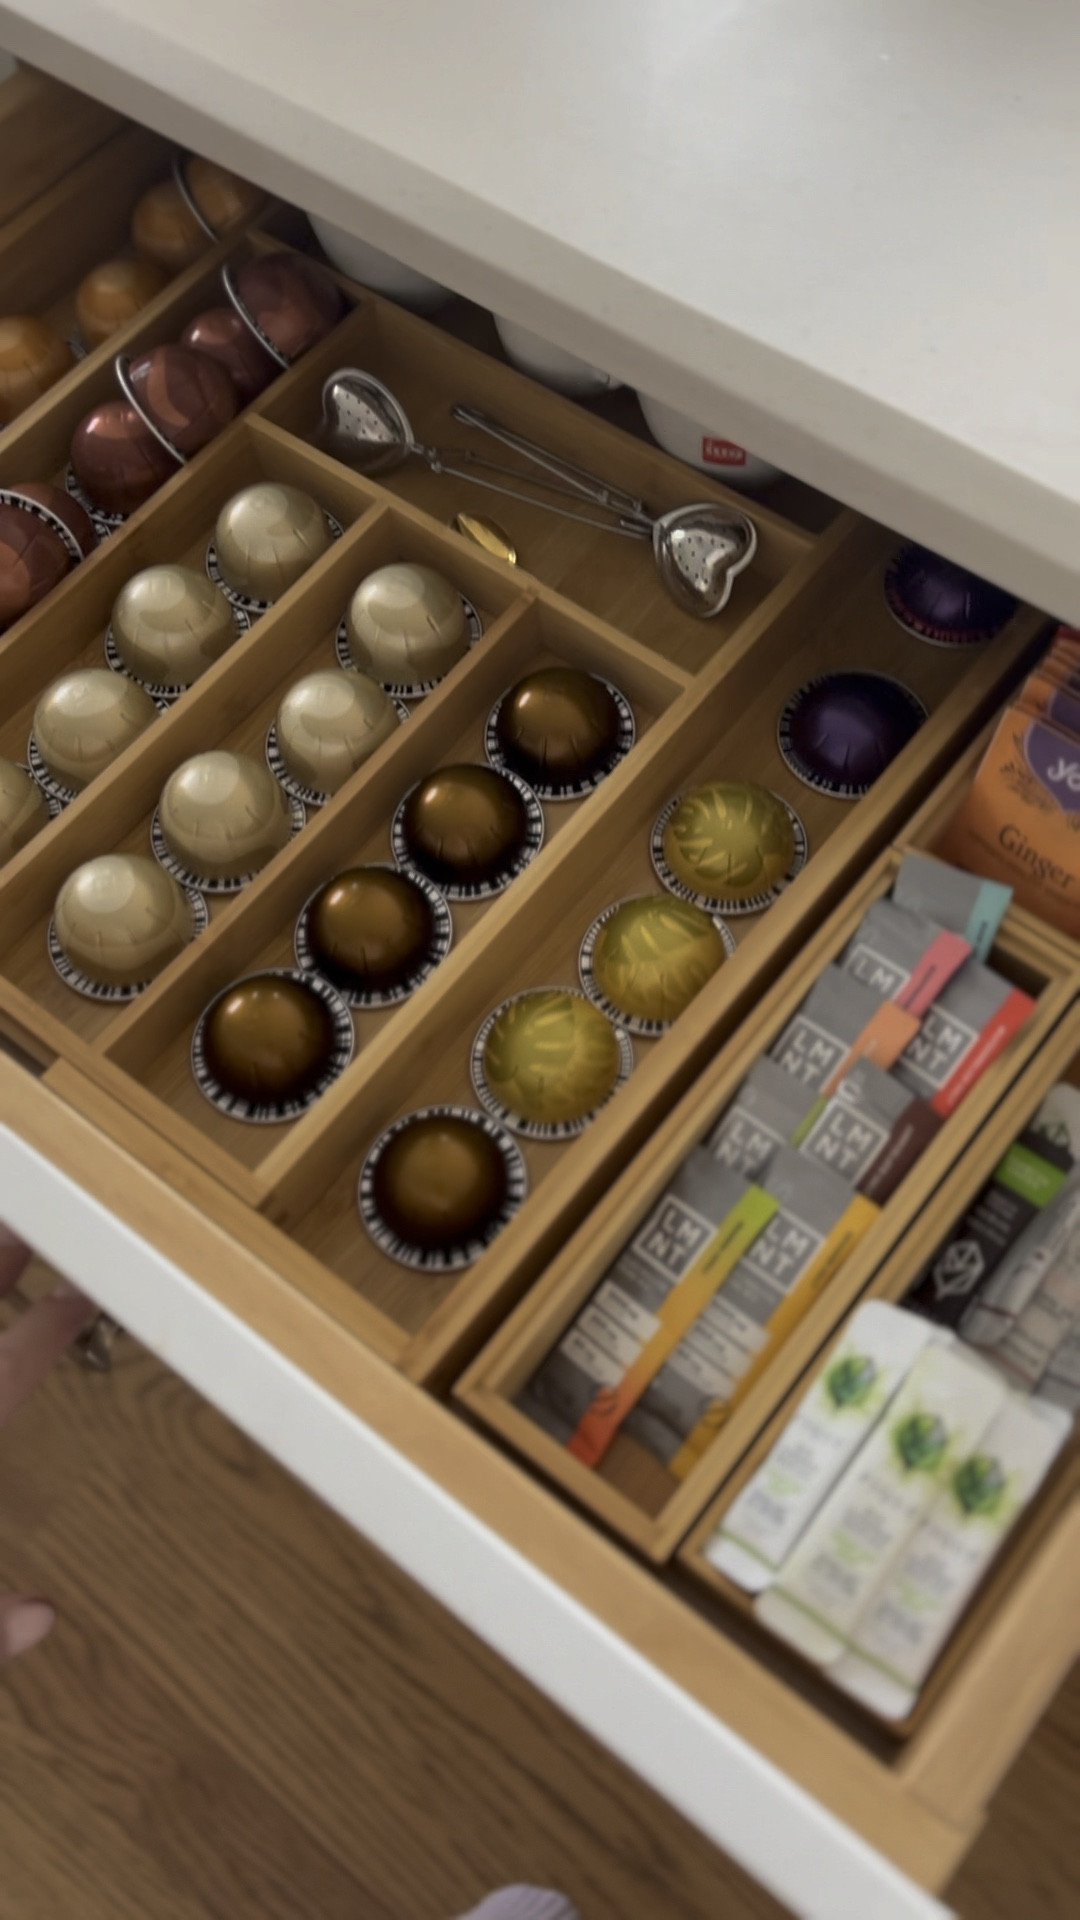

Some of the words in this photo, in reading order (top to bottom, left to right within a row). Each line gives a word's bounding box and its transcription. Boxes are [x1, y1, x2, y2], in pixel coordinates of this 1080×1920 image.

[999, 825, 1074, 888] Ginger
[855, 958, 894, 993] LM
[792, 1029, 834, 1067] LM
[907, 1036, 949, 1070] NT
[922, 1016, 961, 1053] LM
[780, 1050, 820, 1084] NT
[730, 1121, 772, 1160] LM
[829, 1113, 873, 1151] LM
[815, 1134, 858, 1170] NT
[661, 1208, 701, 1248] LM
[766, 1217, 809, 1257] LM
[648, 1231, 685, 1266] NT
[750, 1238, 794, 1276] NT
